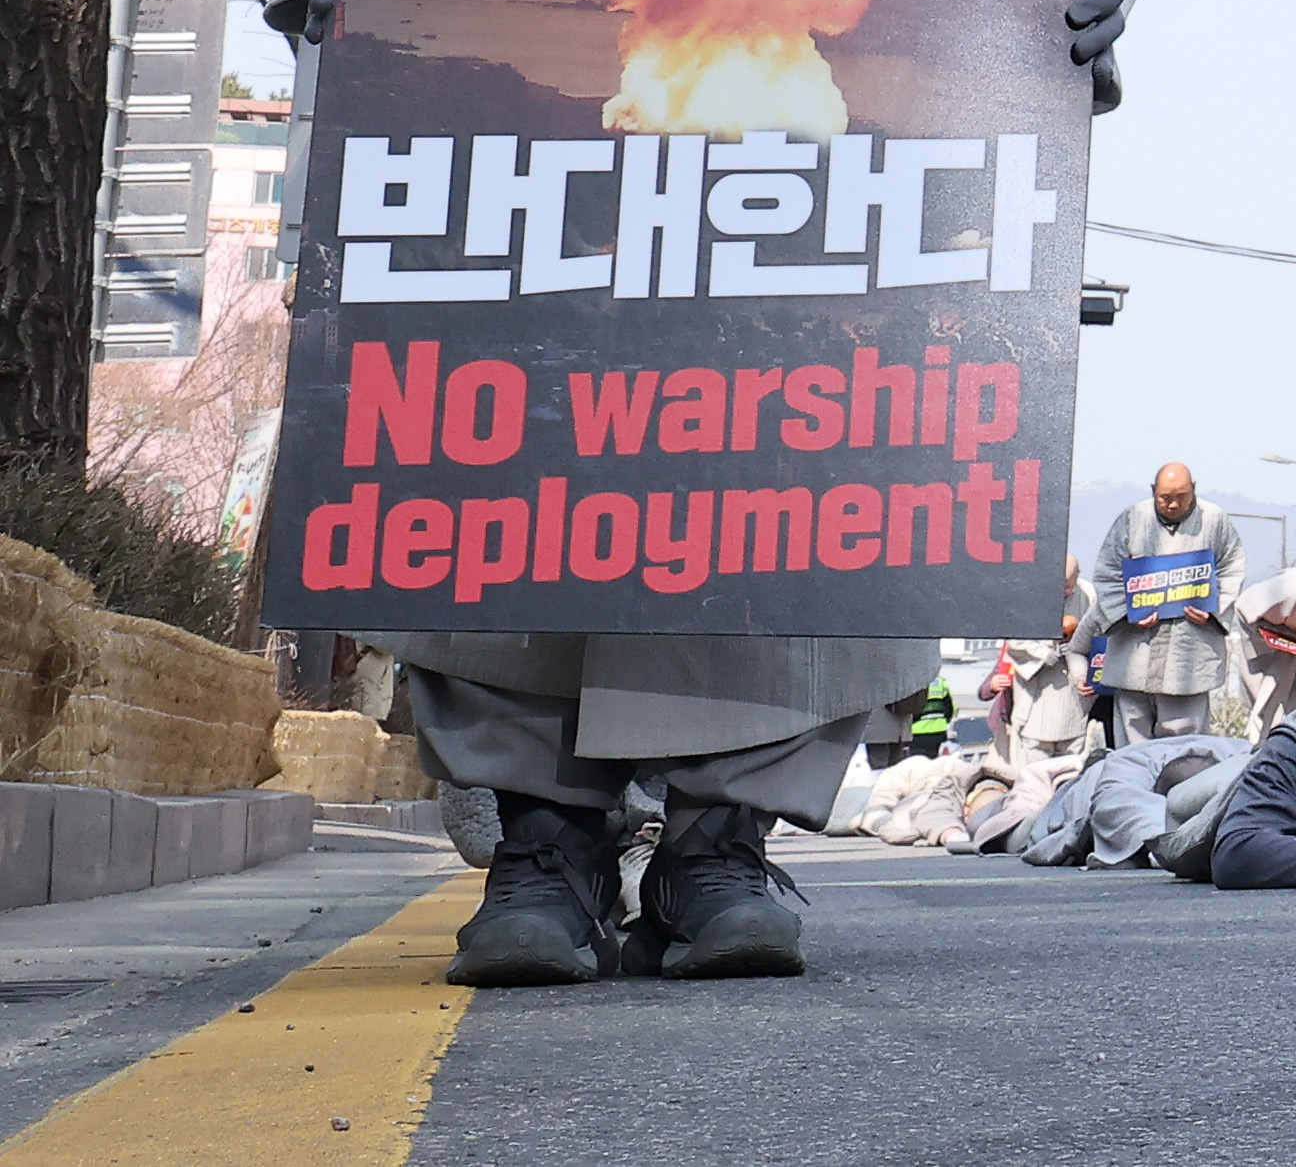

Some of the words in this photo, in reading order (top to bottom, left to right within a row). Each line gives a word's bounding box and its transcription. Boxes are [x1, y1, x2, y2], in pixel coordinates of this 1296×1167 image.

[337, 130, 1058, 303] 반대한다
[343, 340, 527, 468] No
[568, 344, 1020, 462] warship
[301, 458, 1041, 603] deployment!
[1170, 564, 1212, 585] 멈춰라
[1132, 590, 1165, 609] Stop
[1167, 583, 1210, 602] killing
